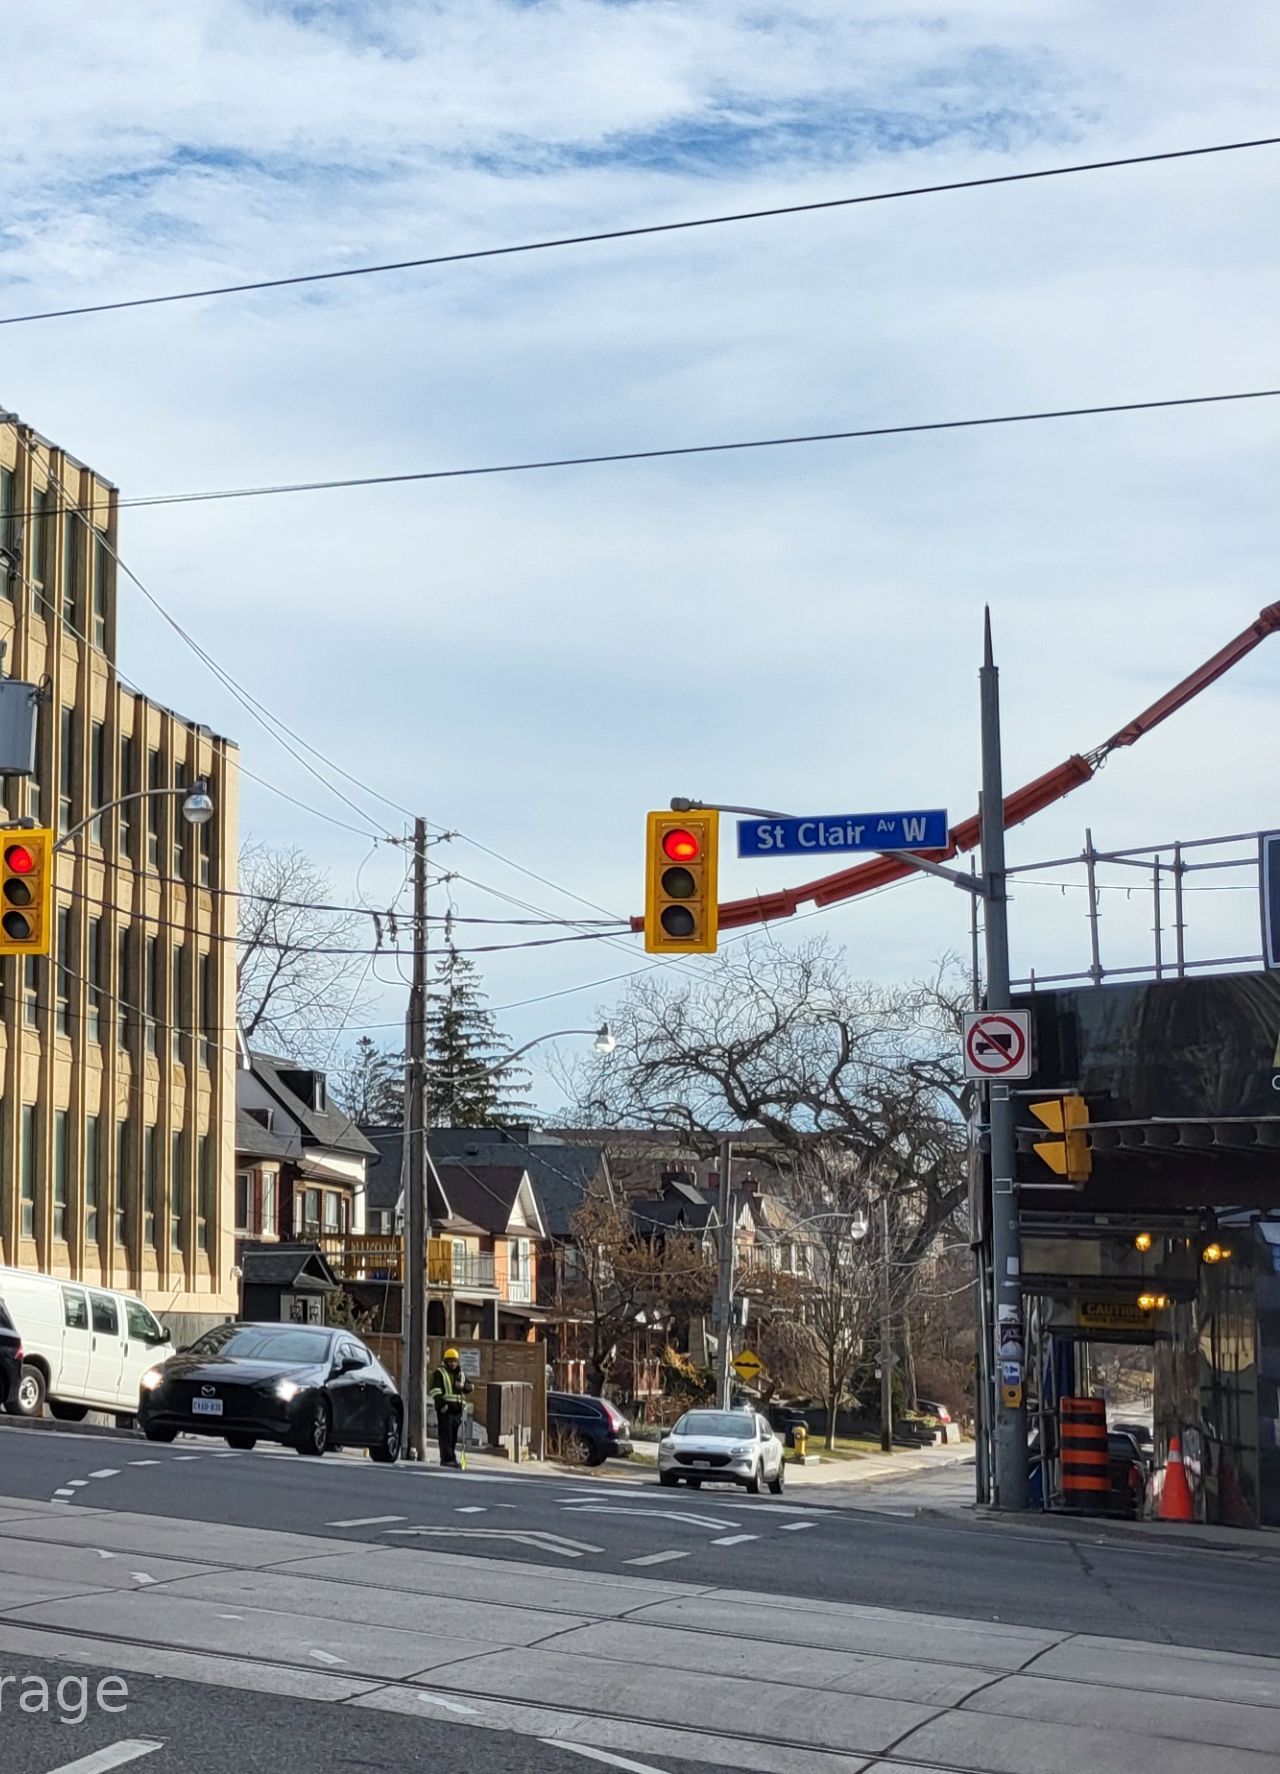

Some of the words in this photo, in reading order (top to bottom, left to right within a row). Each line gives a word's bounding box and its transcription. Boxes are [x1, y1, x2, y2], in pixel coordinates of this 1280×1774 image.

[756, 824, 785, 850] St
[797, 820, 866, 848] Clair
[876, 819, 896, 833] Av
[902, 816, 927, 843] W
